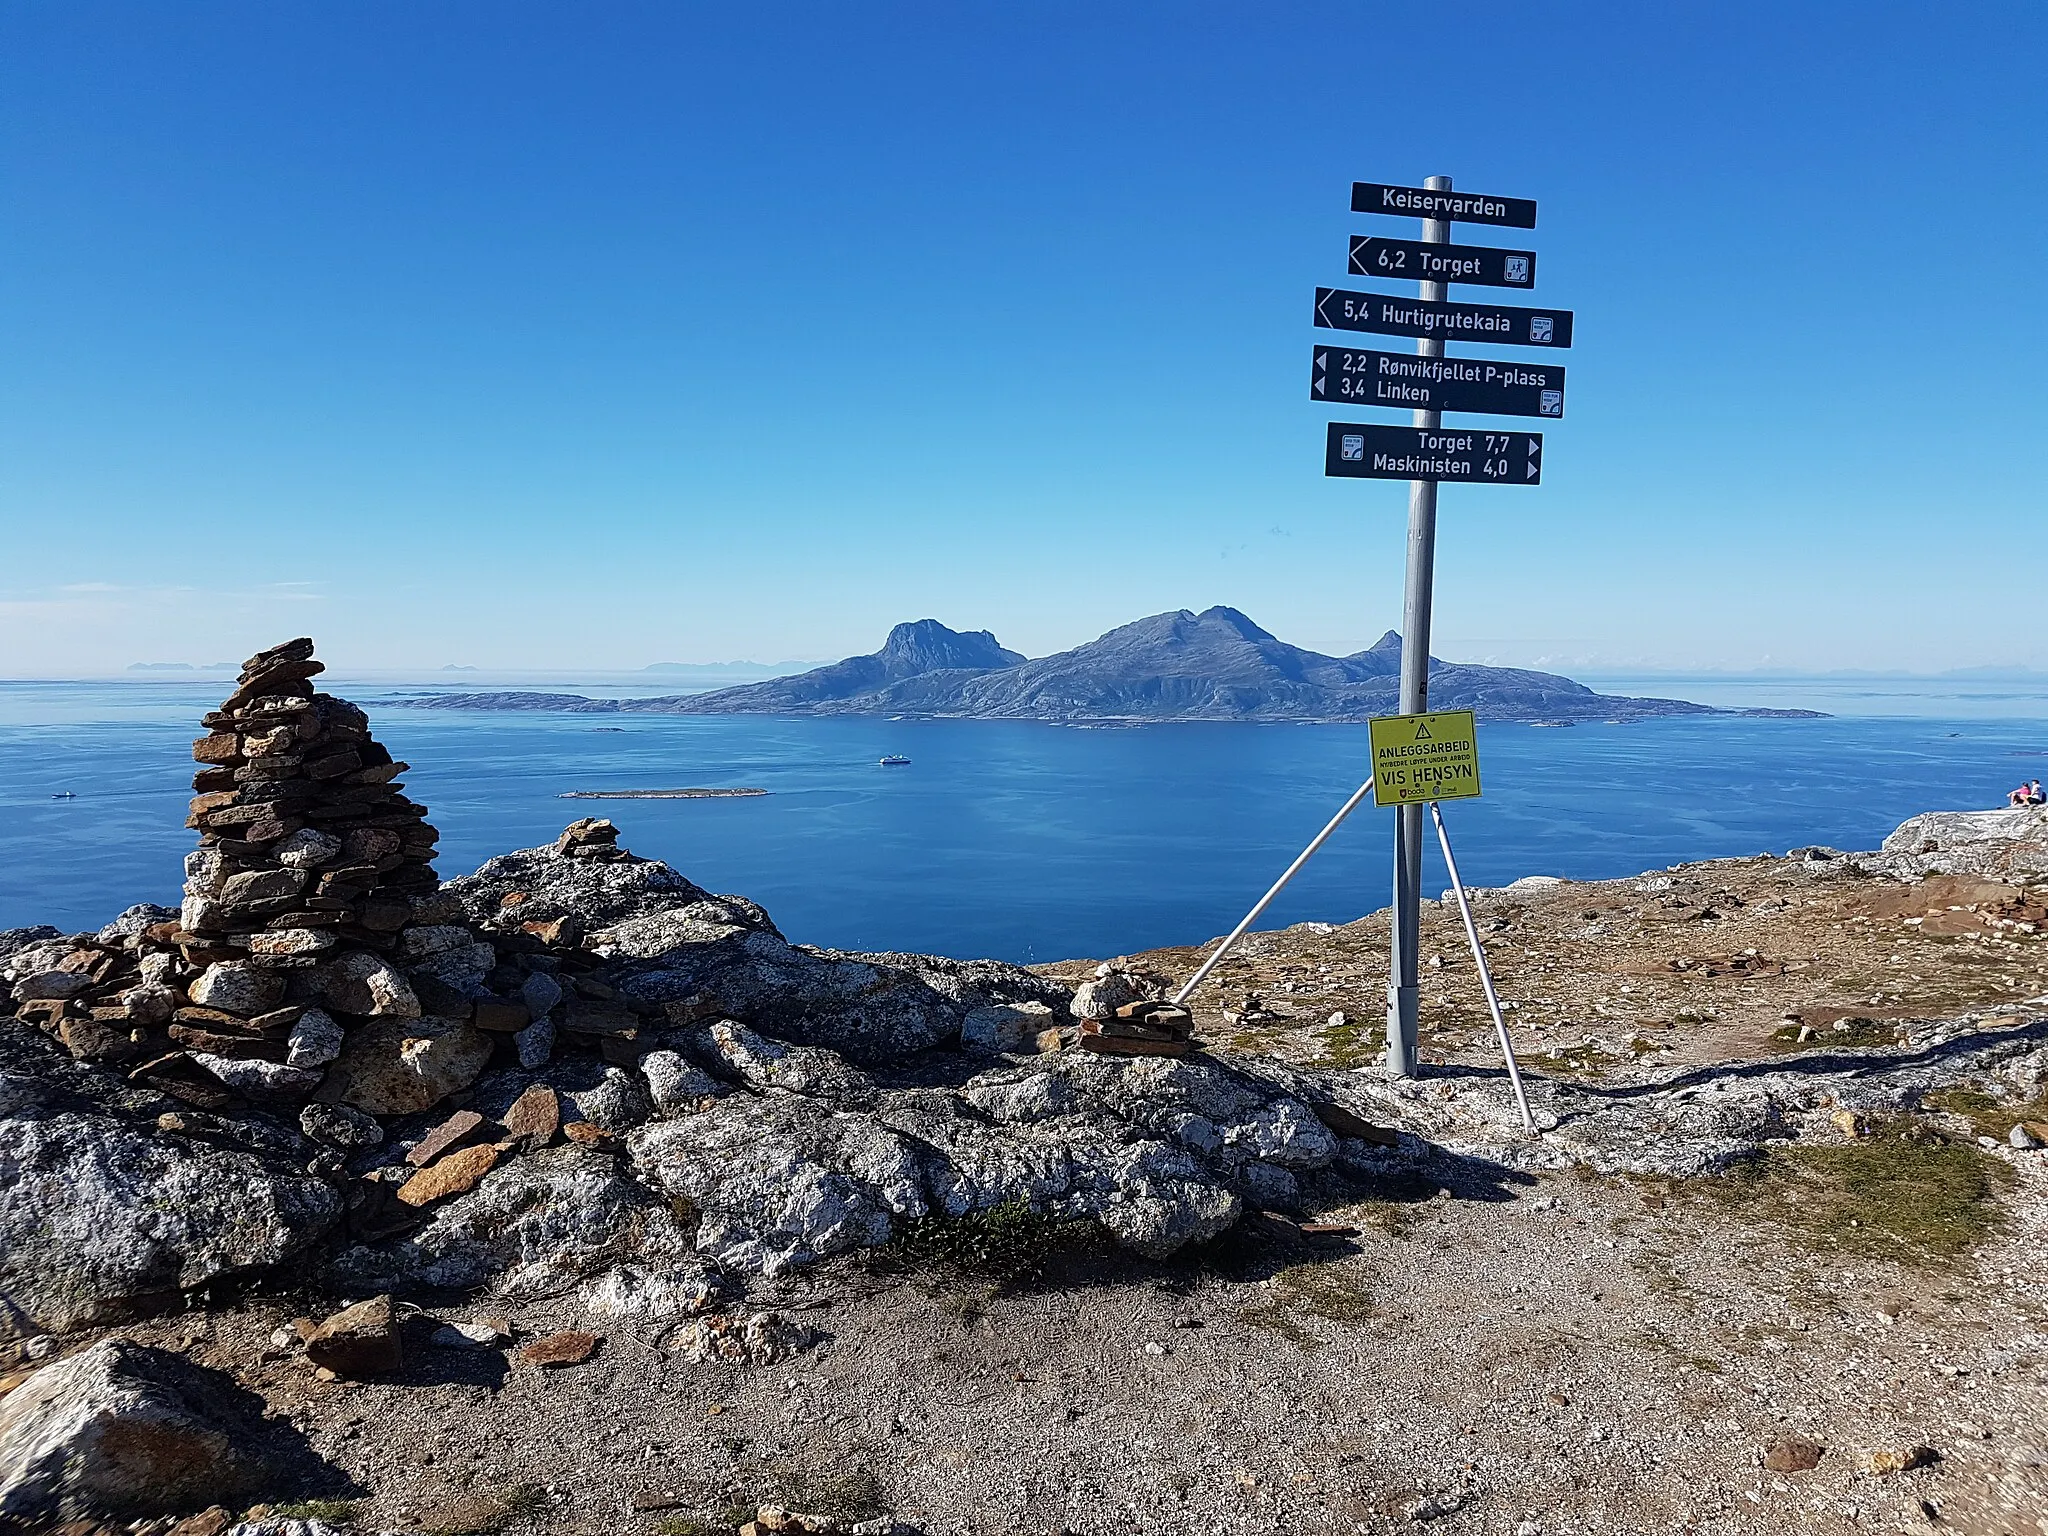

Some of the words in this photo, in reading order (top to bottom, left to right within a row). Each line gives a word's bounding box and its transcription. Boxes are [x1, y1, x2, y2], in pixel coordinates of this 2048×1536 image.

[1382, 188, 1506, 217] Keiservarden
[1378, 249, 1405, 270] 6,2
[1420, 252, 1481, 277] Torget
[1344, 300, 1369, 320] 5,4
[1382, 305, 1511, 331] Hurtigrutekaia
[1343, 354, 1367, 373] 2,2
[1378, 357, 1481, 383] Rønvikfjellet
[1485, 367, 1546, 388] P-plass
[1341, 377, 1365, 397] 3,4
[1377, 382, 1430, 402] Linken
[1418, 432, 1472, 453] Torget
[1485, 435, 1510, 454] 7,7
[1373, 454, 1471, 474] Maskinisten
[1483, 459, 1508, 478] 4,0
[1379, 740, 1470, 758] ANLEGGSARBEID
[1381, 770, 1406, 786] VIS
[1413, 764, 1472, 782] HENSYN
